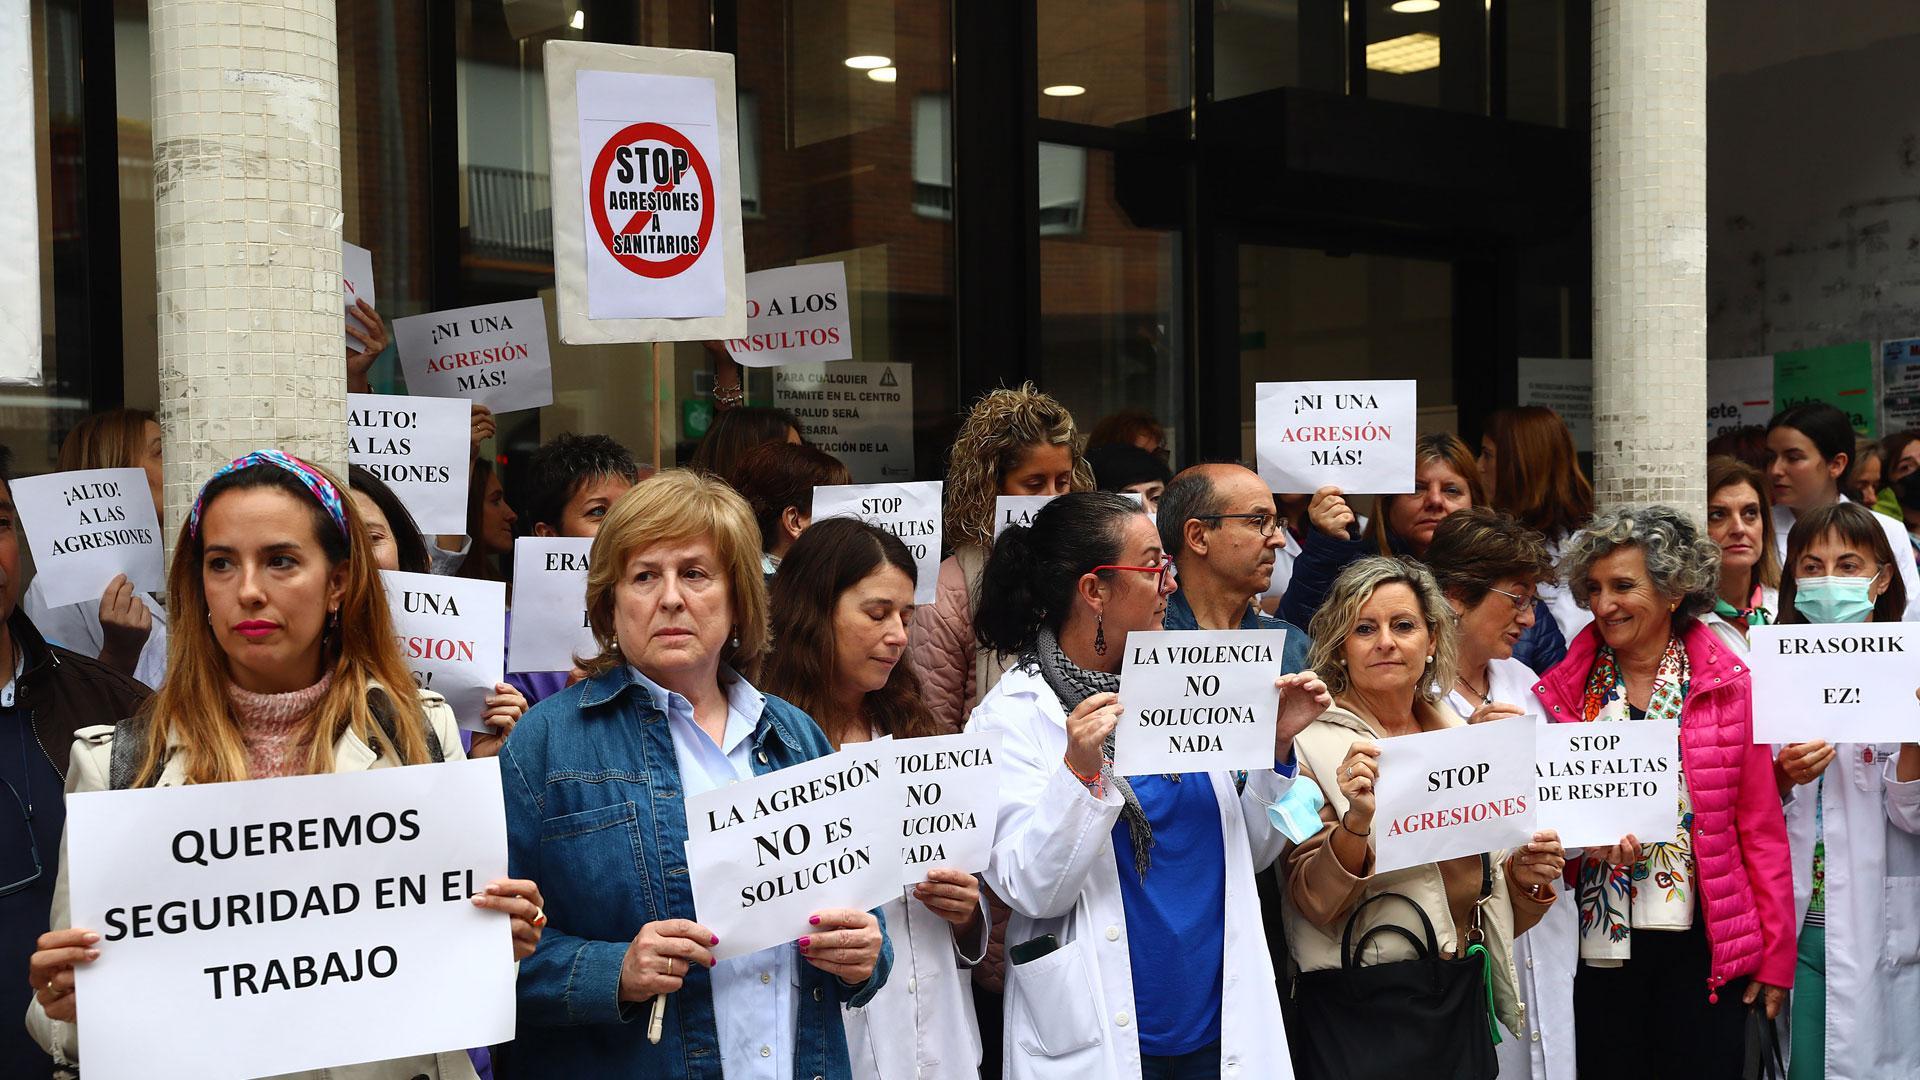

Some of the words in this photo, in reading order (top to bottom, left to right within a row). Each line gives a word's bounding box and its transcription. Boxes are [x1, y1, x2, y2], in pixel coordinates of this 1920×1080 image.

[615, 145, 690, 185] STOP
[609, 191, 699, 212] AGRESIONES
[652, 213, 661, 233] A
[613, 234, 699, 255] SANITARIOS
[768, 298, 784, 316] A
[790, 292, 837, 314] LOS
[431, 322, 460, 344] ¡NI
[471, 315, 513, 334] UNA
[426, 340, 529, 374] AGRESIÓN
[457, 369, 507, 391] MÁS!
[777, 373, 804, 383] PARA
[808, 373, 868, 384] CUALQUIER
[777, 390, 824, 401] TRAMITE
[827, 391, 841, 401] EN
[844, 392, 857, 402] EL
[859, 392, 901, 402] CENTRO
[1294, 395, 1323, 415] ¡NI
[1335, 394, 1379, 410] UNA
[347, 410, 417, 429] ALTO!
[795, 407, 829, 418] SALUD
[833, 407, 860, 418] SERÁ
[800, 425, 839, 435] ESARIA
[1281, 421, 1393, 442] AGRESIÓN
[348, 437, 361, 454] A
[368, 437, 411, 455] LAS
[860, 443, 873, 452] DE
[876, 443, 889, 452] LA
[1311, 446, 1363, 466] MÁS!
[64, 481, 122, 506] ¡ALTO!
[79, 510, 92, 525] A
[94, 505, 126, 522] LAS
[862, 497, 902, 514] STOP
[52, 529, 153, 556] AGRESIONES
[403, 591, 461, 616] UNA
[1133, 647, 1160, 665] LA
[1167, 645, 1273, 664] VIOLENCIA
[1778, 636, 1904, 655] ERASORIK
[1184, 675, 1220, 697] NO
[1823, 688, 1860, 704] EZ!
[1139, 706, 1256, 727] SOLUCIONA
[1169, 735, 1224, 753] NADA
[1570, 735, 1620, 752] STOP
[1428, 762, 1490, 793] STOP
[1550, 760, 1585, 777] LAS
[1591, 757, 1668, 775] FALTAS
[707, 804, 745, 832] LA
[752, 758, 882, 820] AGRESIÓN
[905, 783, 942, 807] NO
[1538, 785, 1562, 801] DE
[1568, 781, 1657, 800] RESPETO
[902, 812, 977, 837] UCIONA
[1387, 795, 1528, 837] AGRESIONES
[171, 808, 421, 867] QUEREMOS
[752, 823, 811, 867] NO
[824, 817, 852, 844] ES
[901, 843, 947, 865] ADA
[740, 846, 872, 908] SOLUCIÓN
[104, 882, 361, 941] SEGURIDAD
[375, 874, 427, 910] EN
[204, 945, 398, 999] TRABAJO
